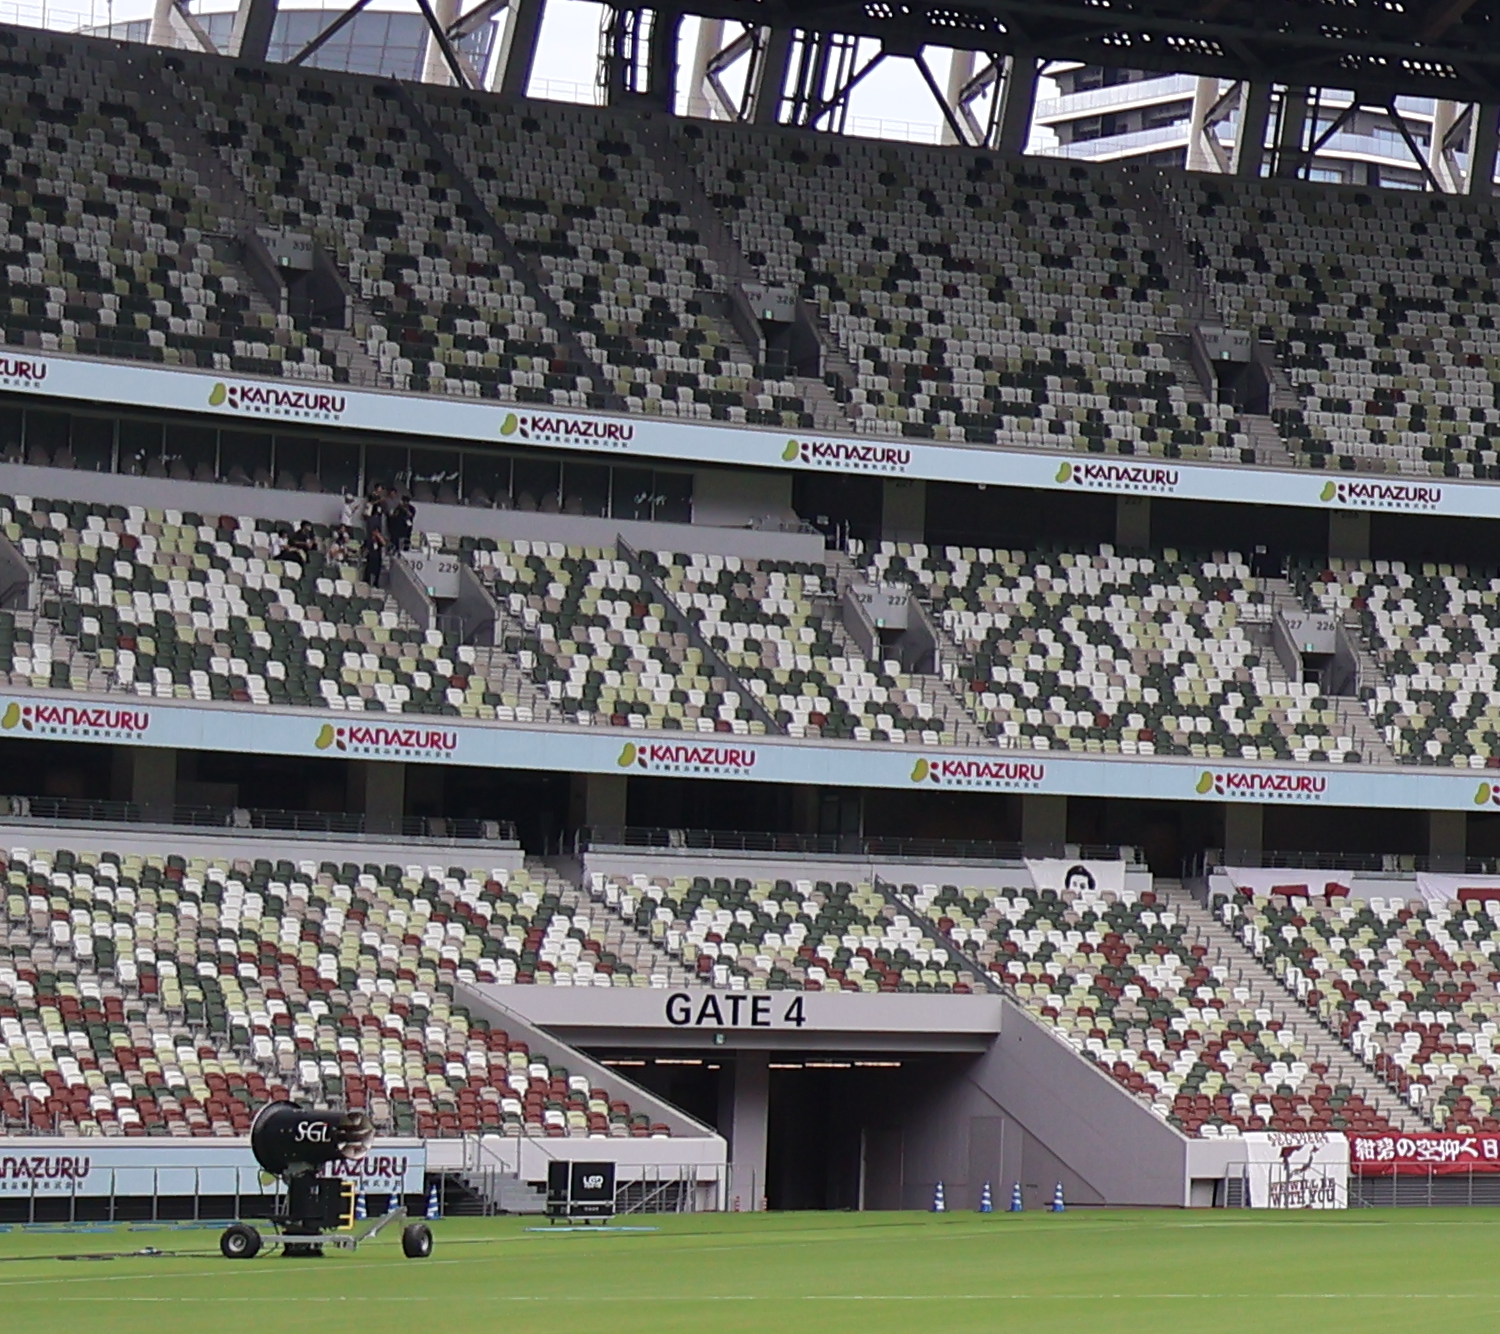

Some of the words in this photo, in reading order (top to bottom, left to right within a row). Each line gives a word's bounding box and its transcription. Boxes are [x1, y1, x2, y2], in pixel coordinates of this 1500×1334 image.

[240, 385, 346, 413] KANAZURU
[530, 416, 633, 441] KANAZURU
[812, 442, 911, 464] KANAZURU
[1083, 463, 1178, 487] KANAZURU
[1347, 482, 1441, 503] KANAZURU
[438, 563, 458, 573] 229
[888, 595, 906, 605] 227
[1317, 621, 1335, 631] 226
[34, 705, 148, 731] KANAZURU
[349, 726, 456, 750] KANAZURU
[648, 745, 755, 769] KANAZURU
[941, 760, 1044, 783] KANAZURU
[1225, 773, 1325, 795] KANAZURU
[665, 993, 772, 1027] GATE
[784, 995, 808, 1027] 4
[0, 1156, 90, 1179] NAZURU
